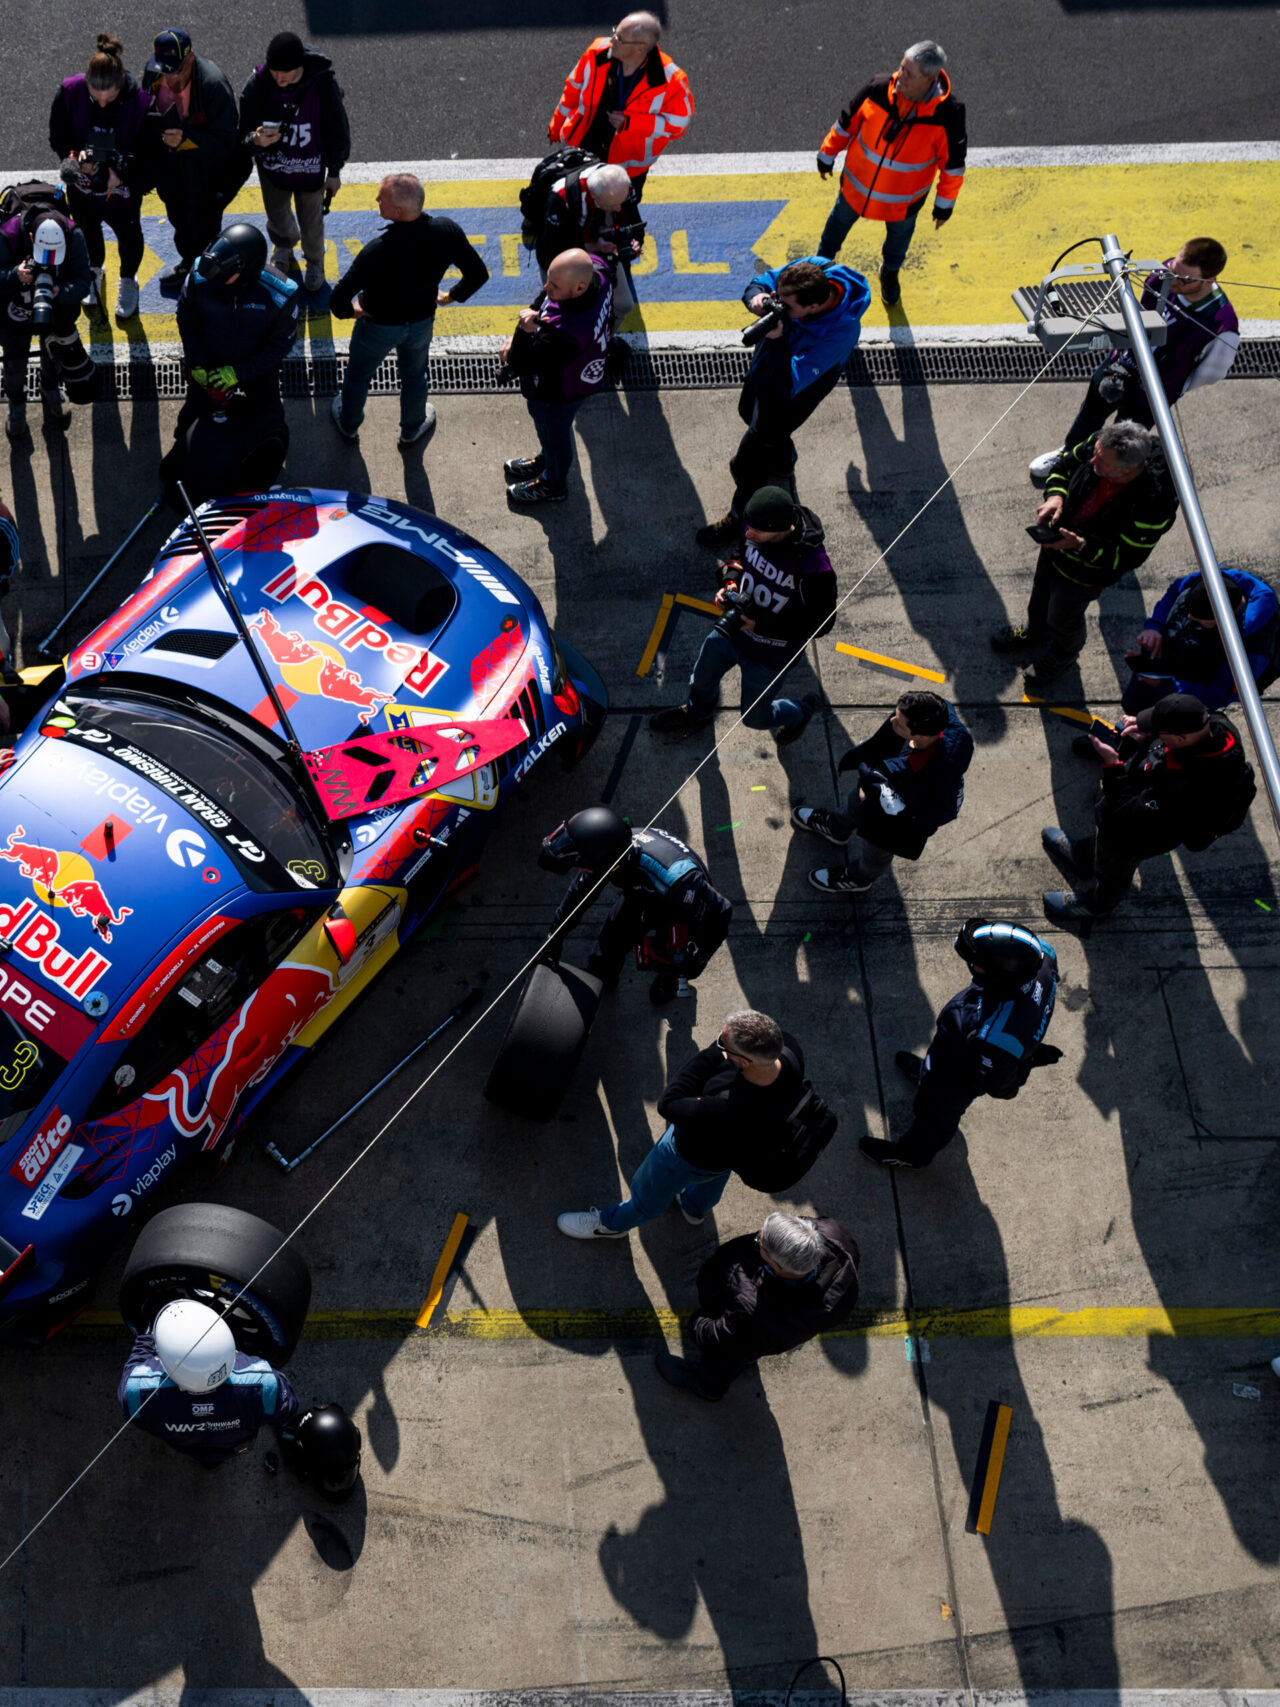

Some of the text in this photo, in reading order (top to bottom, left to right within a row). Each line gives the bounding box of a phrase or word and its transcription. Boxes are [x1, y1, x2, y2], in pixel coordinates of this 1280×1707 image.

[745, 546, 796, 589] MEDIA
[740, 571, 790, 614] 007
[124, 616, 166, 659] viaplay
[515, 721, 567, 783] FALKEN
[70, 760, 168, 835] viaplay
[112, 747, 230, 829] GRAN TURISMO
[127, 744, 233, 824] THE REAL DRIVING SIMULATOR
[287, 859, 326, 881] 3
[18, 1133, 46, 1170] sport
[24, 1114, 72, 1182] auto
[130, 1143, 178, 1196] viaplay
[192, 1405, 215, 1414] OMP
